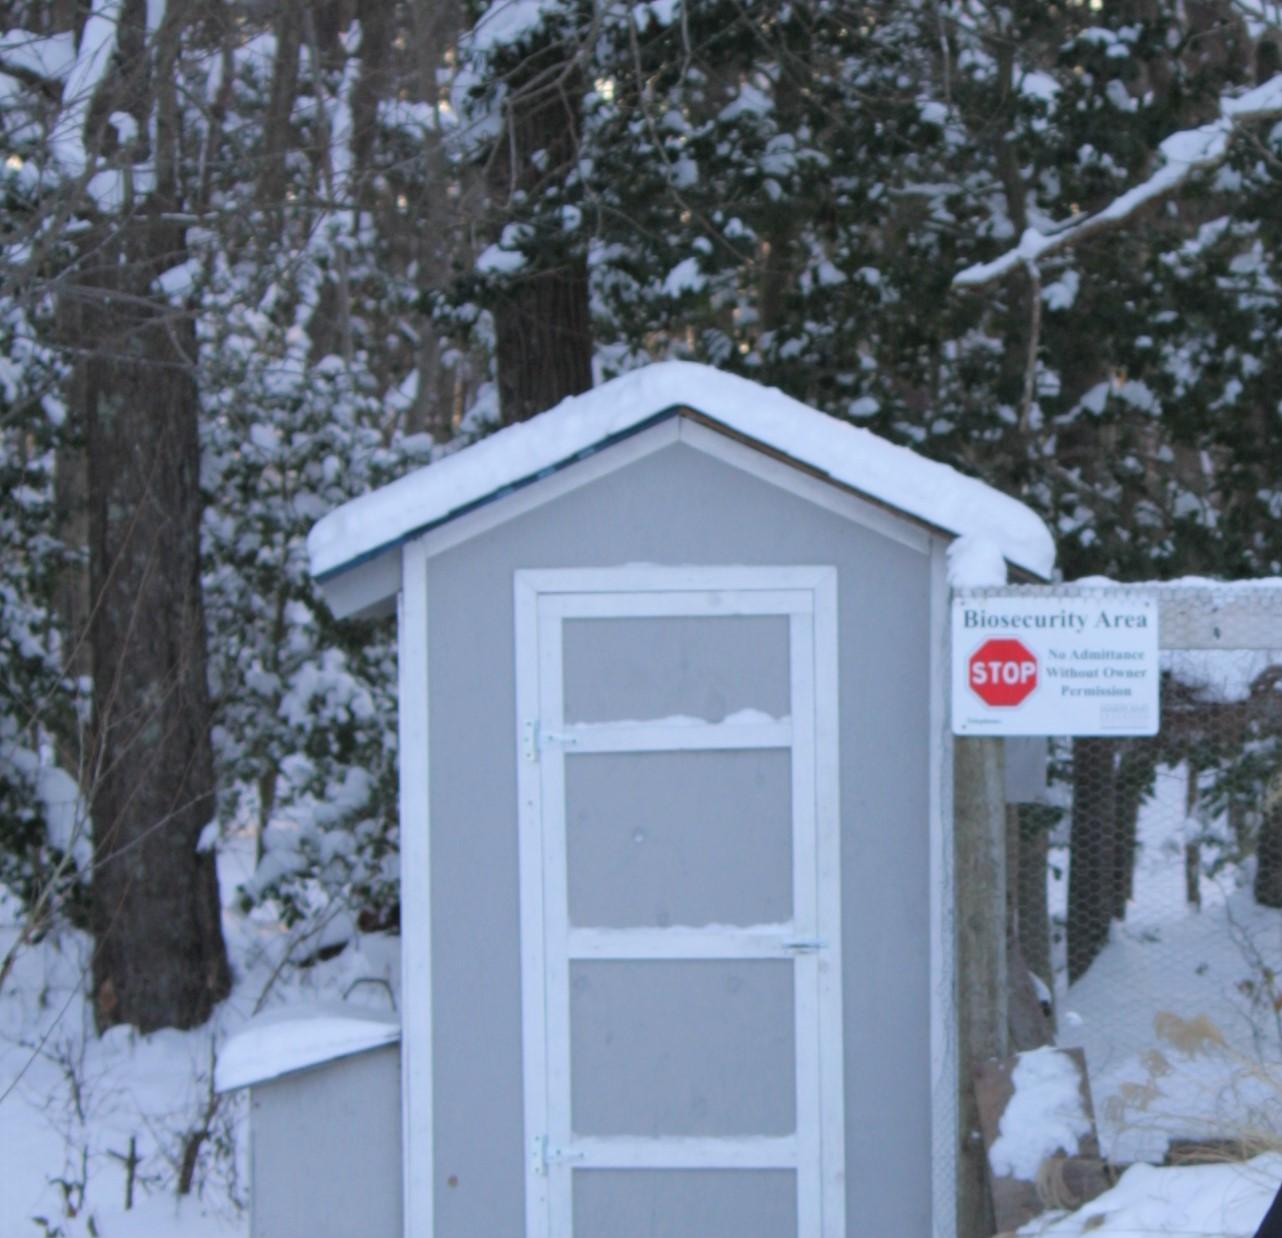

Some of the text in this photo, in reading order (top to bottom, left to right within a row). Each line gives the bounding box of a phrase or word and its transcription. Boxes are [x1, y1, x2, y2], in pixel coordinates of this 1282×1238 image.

[963, 609, 1148, 633] Biosecurity Area
[1048, 648, 1145, 660] No Admittance
[972, 661, 1036, 685] STOP
[1046, 667, 1146, 679] Without Owner
[1061, 685, 1132, 696] Permission
